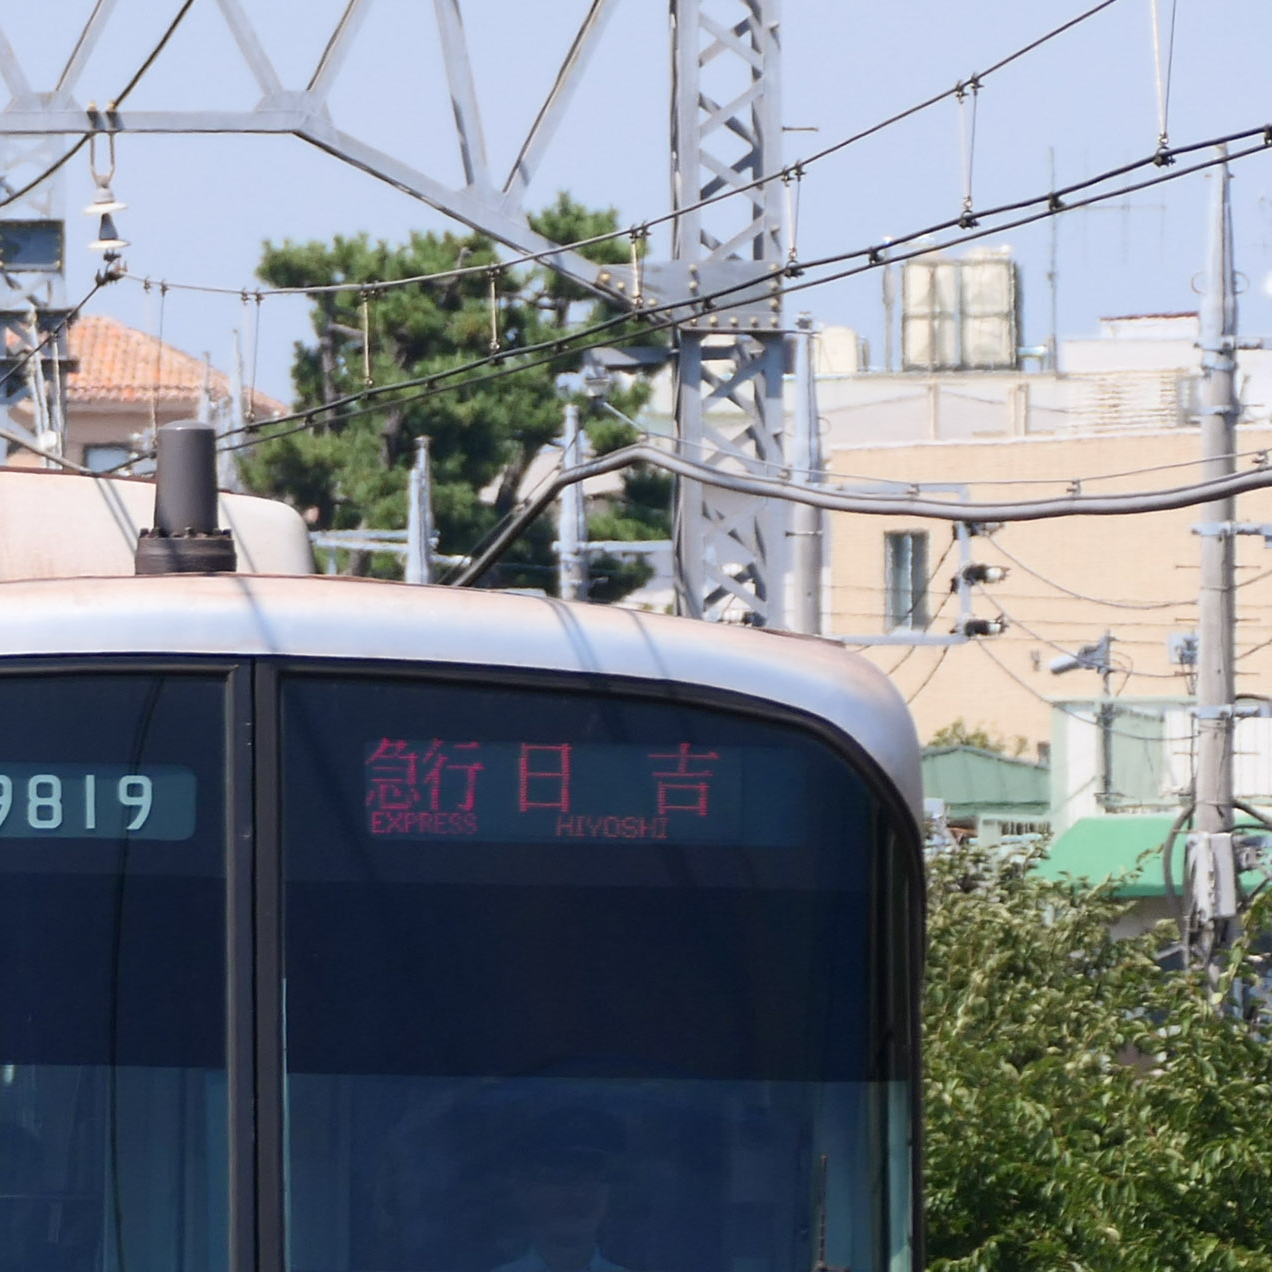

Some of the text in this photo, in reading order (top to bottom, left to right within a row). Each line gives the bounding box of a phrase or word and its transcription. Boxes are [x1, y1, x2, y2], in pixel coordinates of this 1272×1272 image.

[364, 737, 485, 812] 急行
[370, 813, 478, 834] EXPRESS
[555, 816, 670, 839] HIYOSHI
